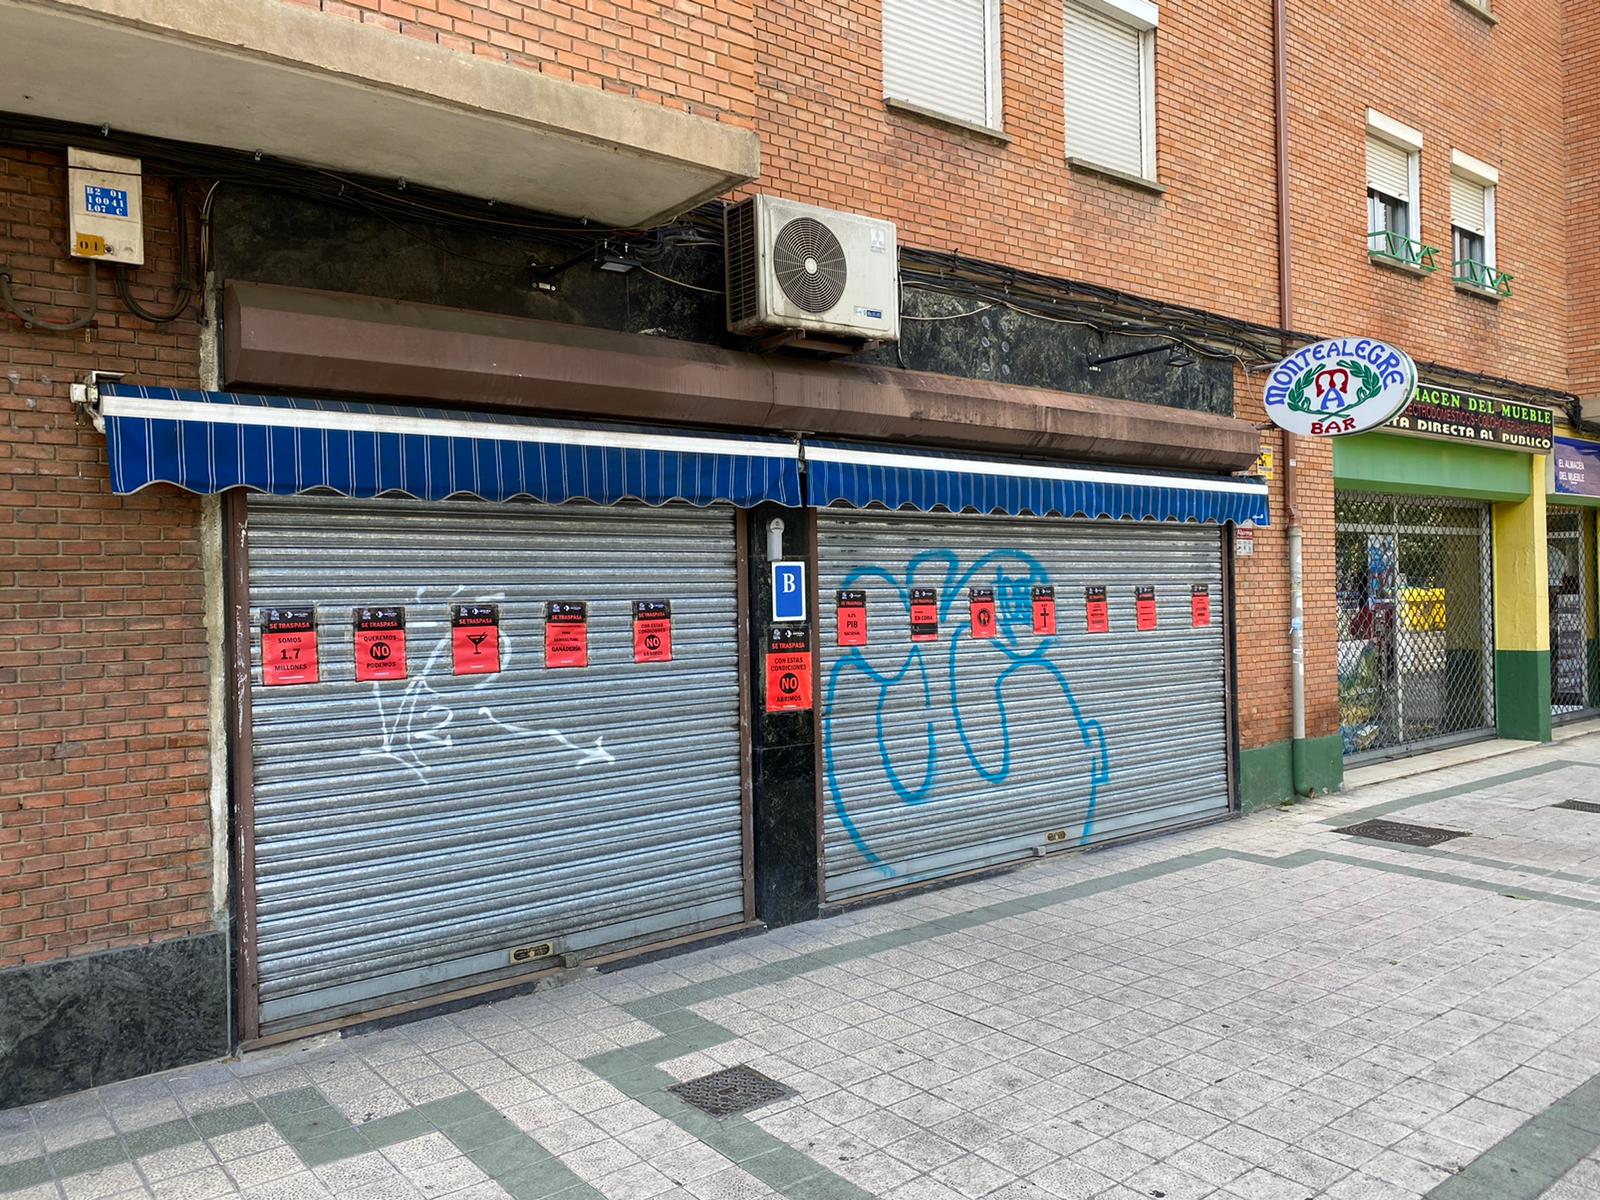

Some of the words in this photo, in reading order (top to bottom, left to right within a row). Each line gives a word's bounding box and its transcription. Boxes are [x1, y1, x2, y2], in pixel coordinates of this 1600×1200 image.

[86, 186, 101, 196] B2
[110, 190, 122, 199] 01
[1264, 339, 1405, 406] MONTEALEGRE
[1469, 398, 1495, 414] DEL
[1501, 406, 1552, 425] MUEBLE
[1310, 417, 1356, 435] BAR
[1417, 419, 1475, 438] DIRECTA
[1480, 429, 1494, 441] AL
[1502, 433, 1551, 449] PUBLICO
[782, 573, 796, 593] B
[846, 620, 858, 628] PIB
[646, 637, 660, 647] NO
[280, 648, 301, 660] 1.7
[372, 645, 390, 657] NO
[781, 677, 797, 689] NO
[776, 695, 802, 703] ABRIMOS
